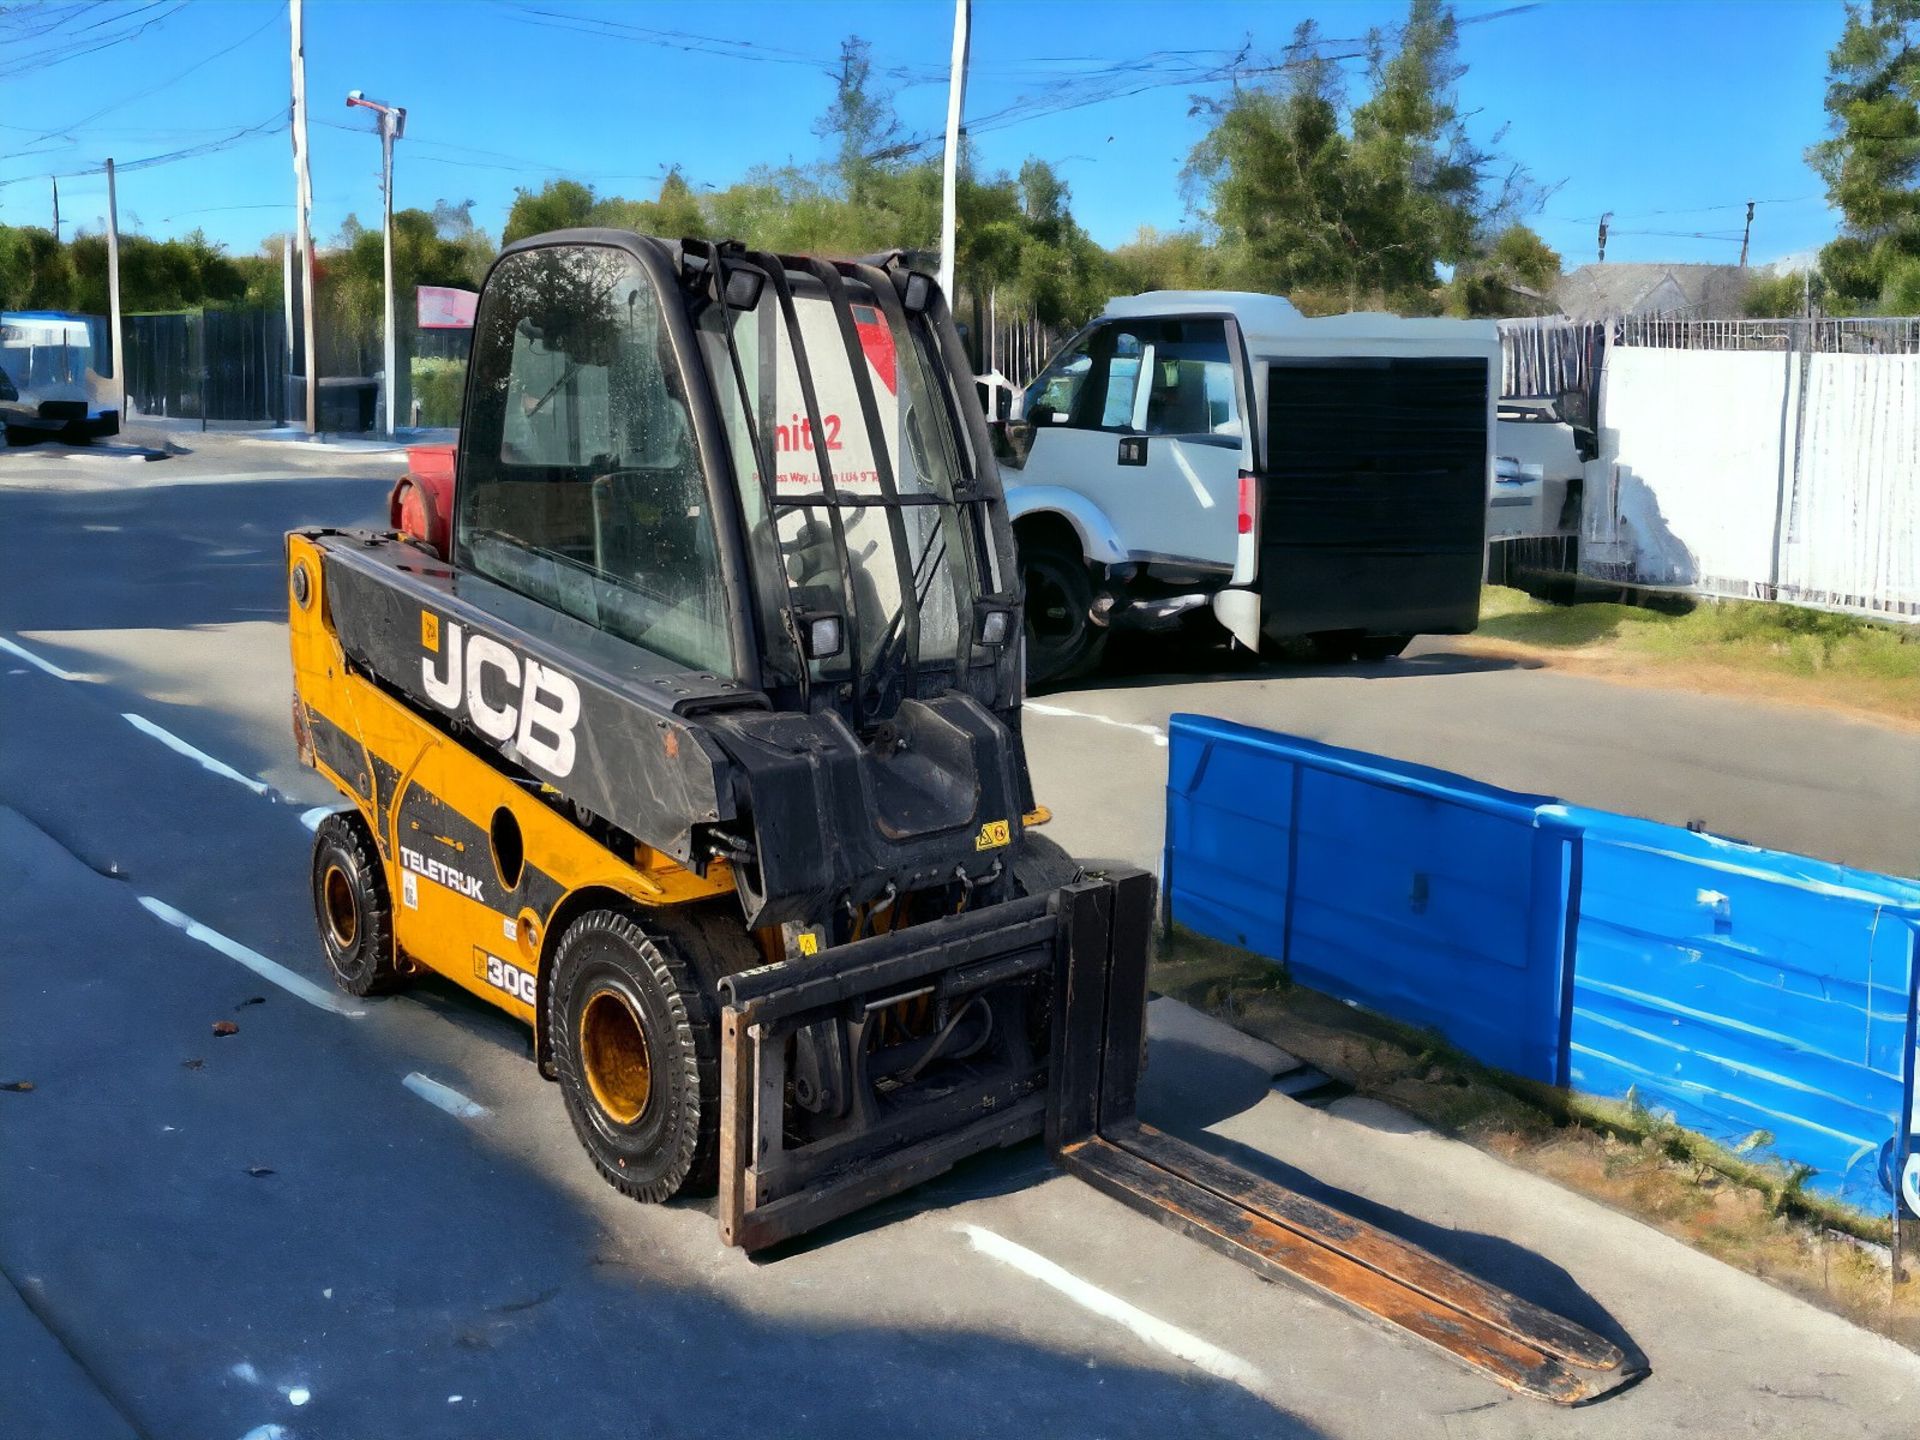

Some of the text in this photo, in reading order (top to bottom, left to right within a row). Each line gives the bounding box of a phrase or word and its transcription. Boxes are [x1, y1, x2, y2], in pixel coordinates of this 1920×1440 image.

[764, 413, 843, 452] nit 2
[422, 621, 581, 778] JCB
[400, 845, 485, 902] TELETRUK
[487, 955, 536, 1007] 30G
